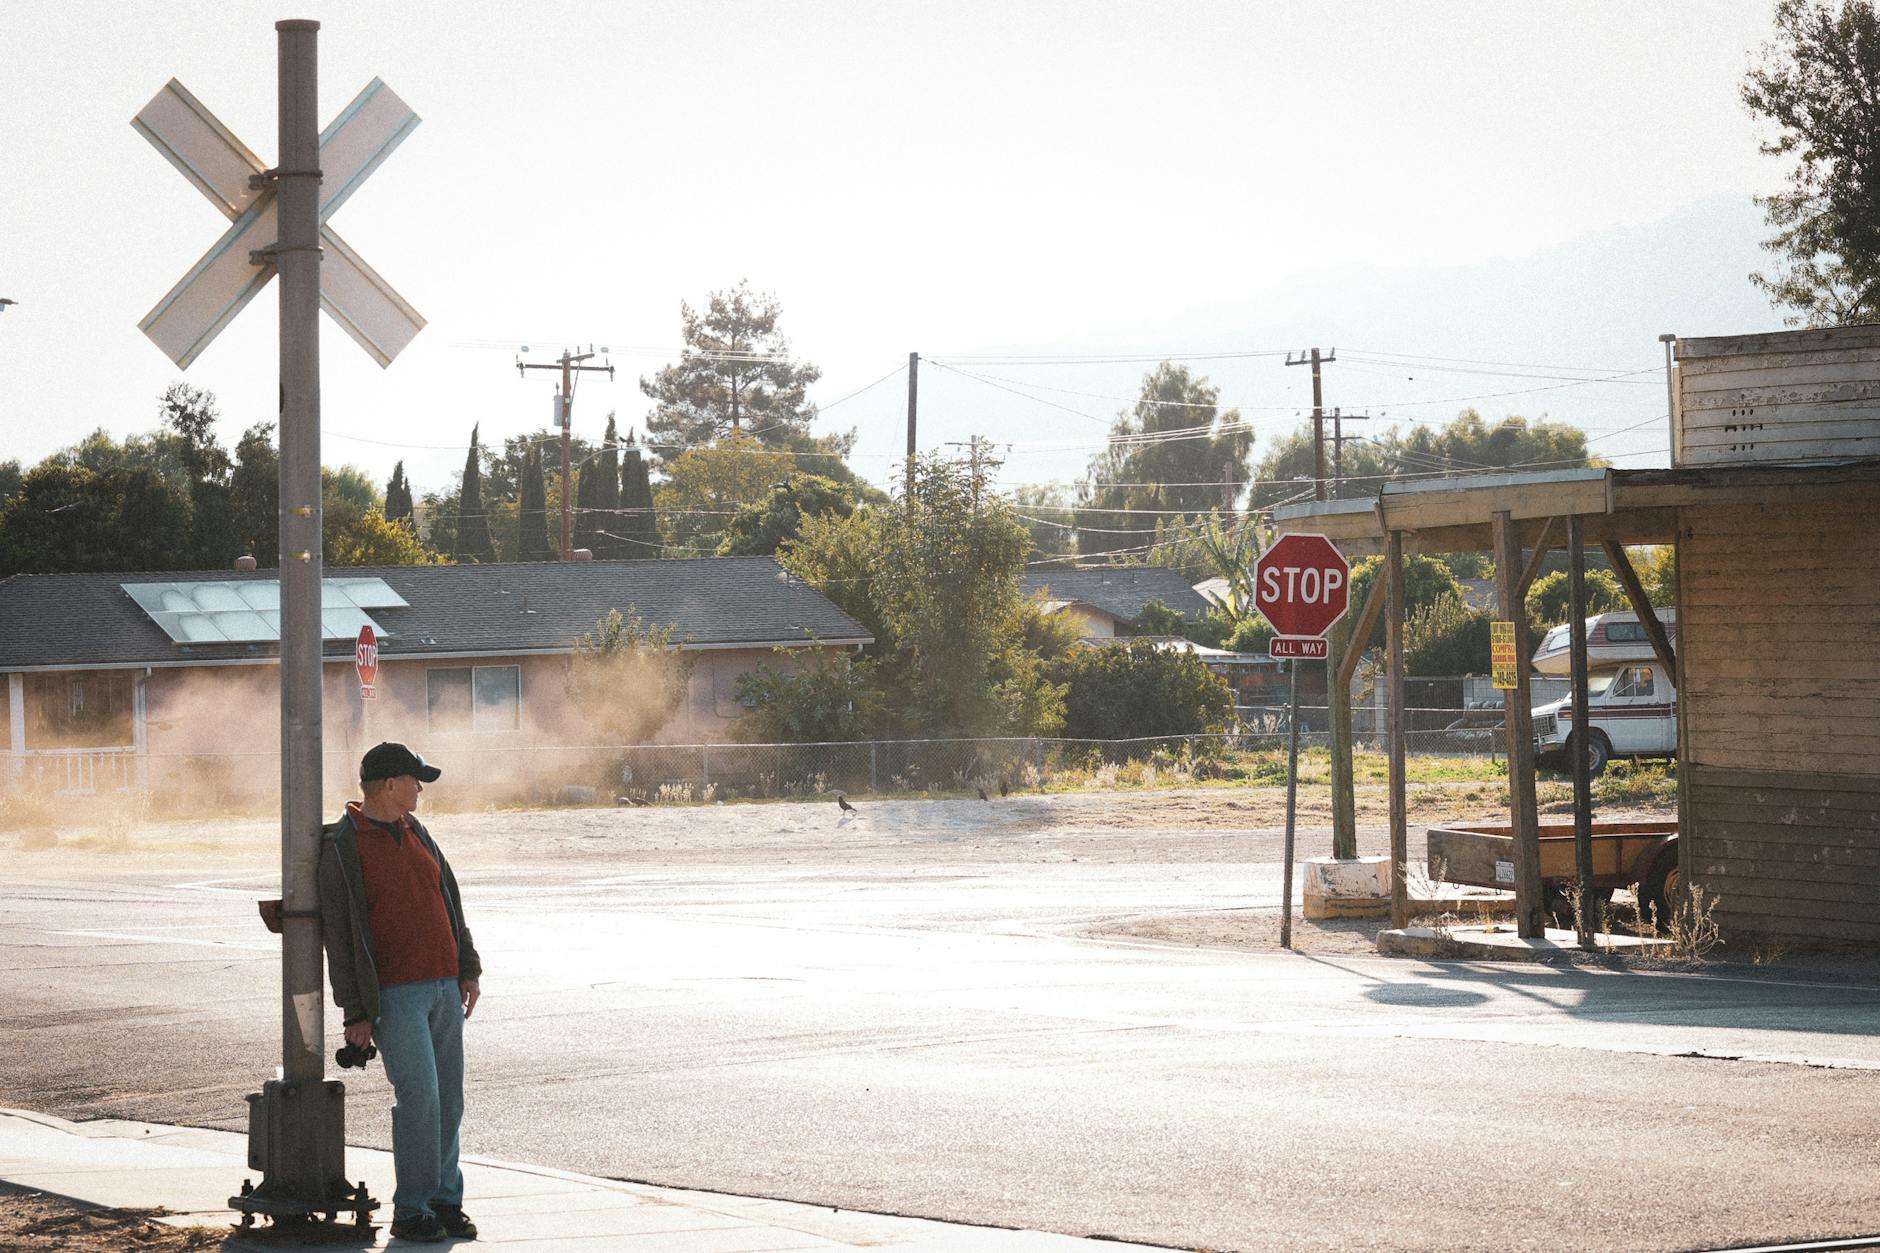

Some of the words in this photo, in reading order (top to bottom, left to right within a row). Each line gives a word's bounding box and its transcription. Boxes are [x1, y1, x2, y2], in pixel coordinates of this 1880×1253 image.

[1261, 566, 1343, 604] STOP
[358, 643, 378, 667] STOP
[1274, 642, 1295, 654] ALL
[1301, 642, 1323, 654] WAY
